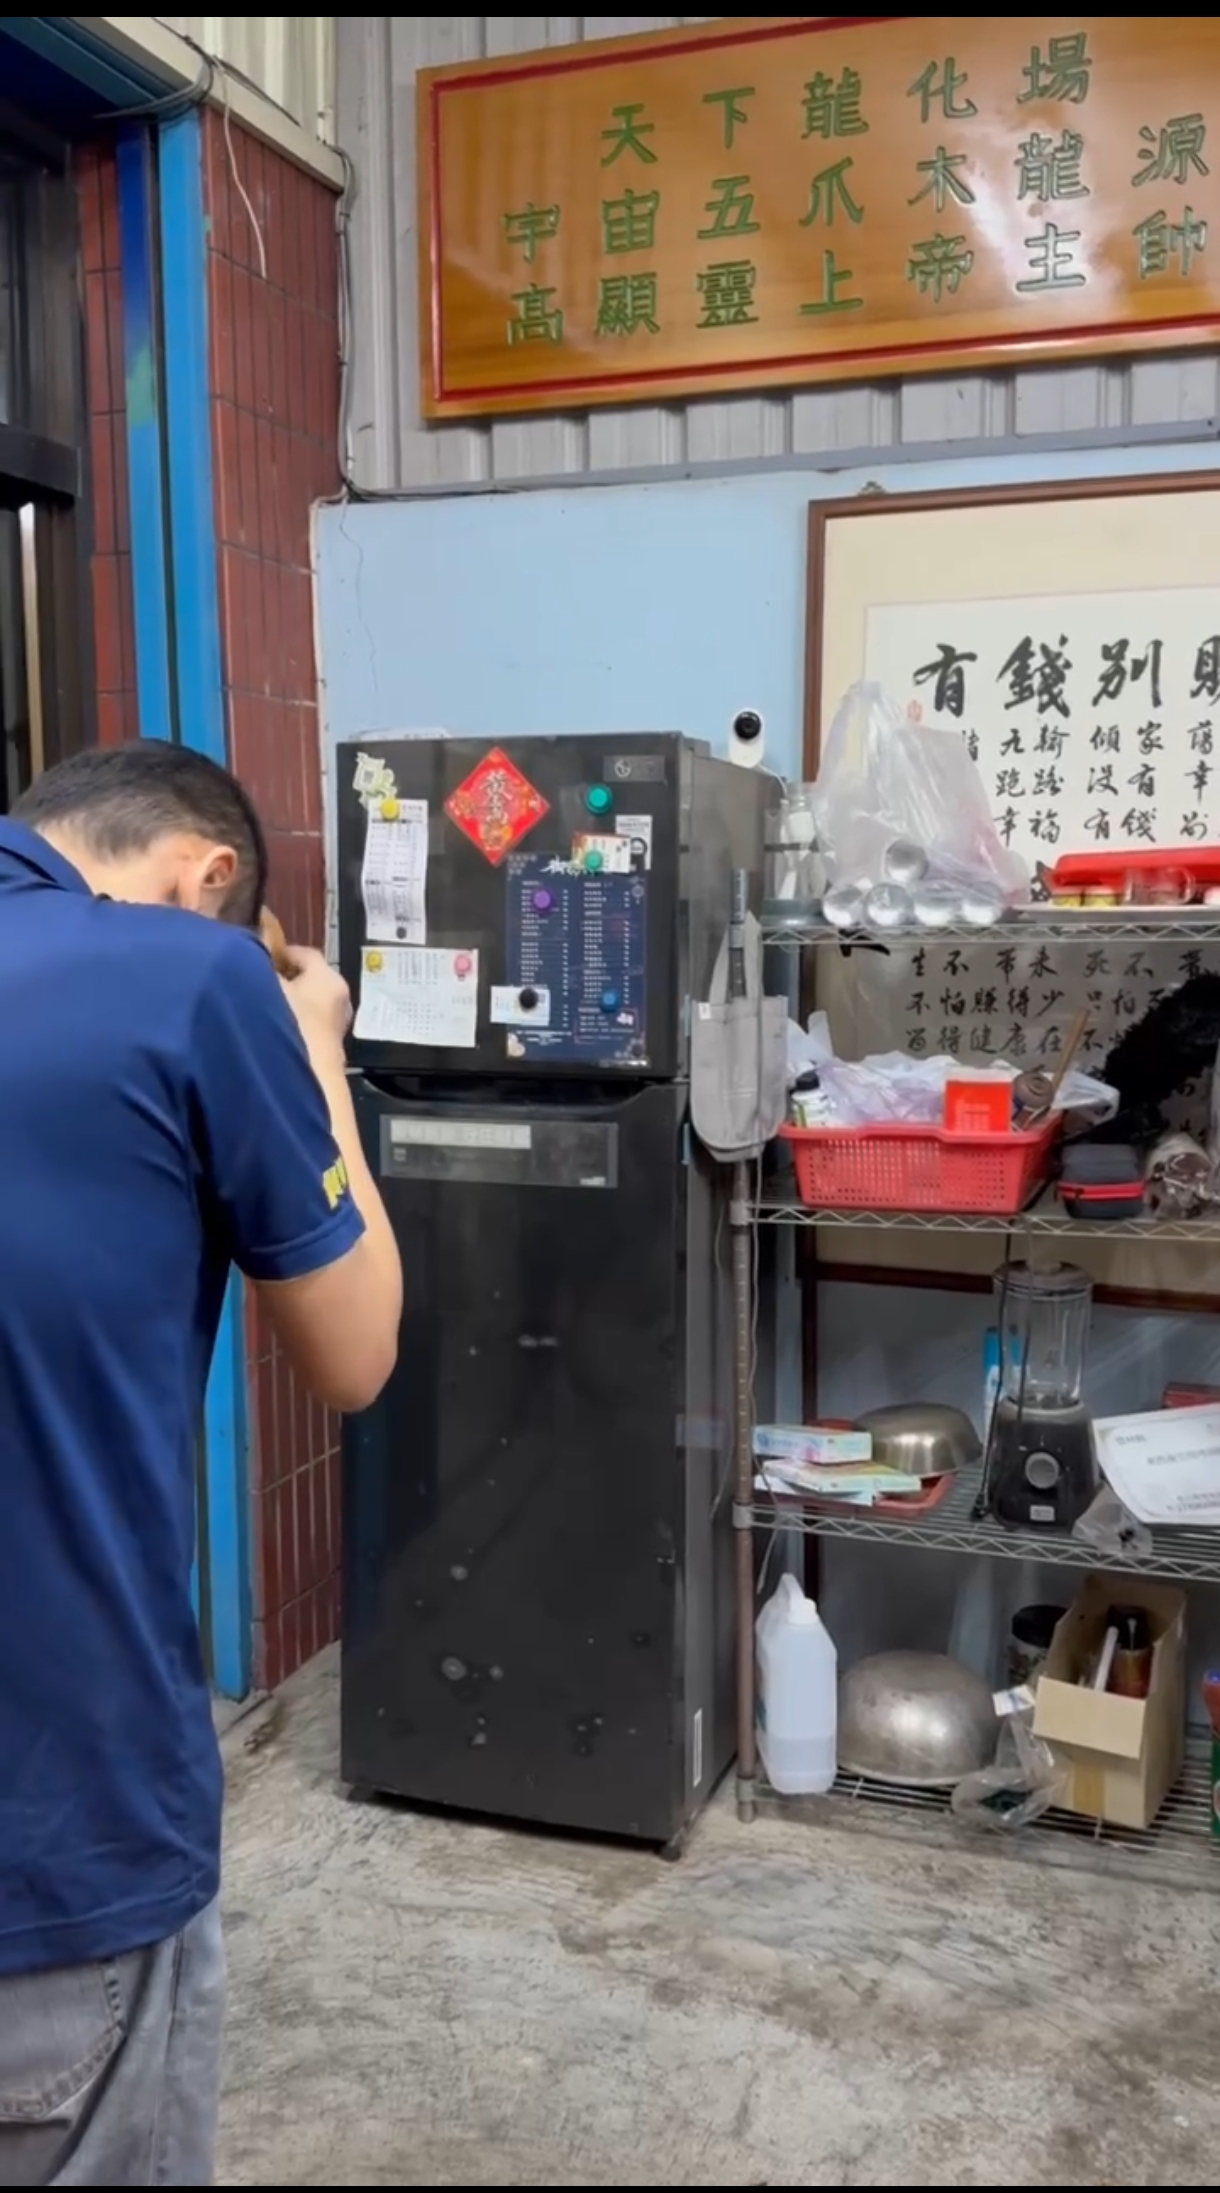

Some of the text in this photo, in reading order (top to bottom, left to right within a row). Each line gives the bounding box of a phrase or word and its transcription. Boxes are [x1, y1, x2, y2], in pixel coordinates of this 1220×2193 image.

[601, 31, 1093, 168] 天下龍化場
[503, 114, 1209, 264] 宇宙五爪木龍源
